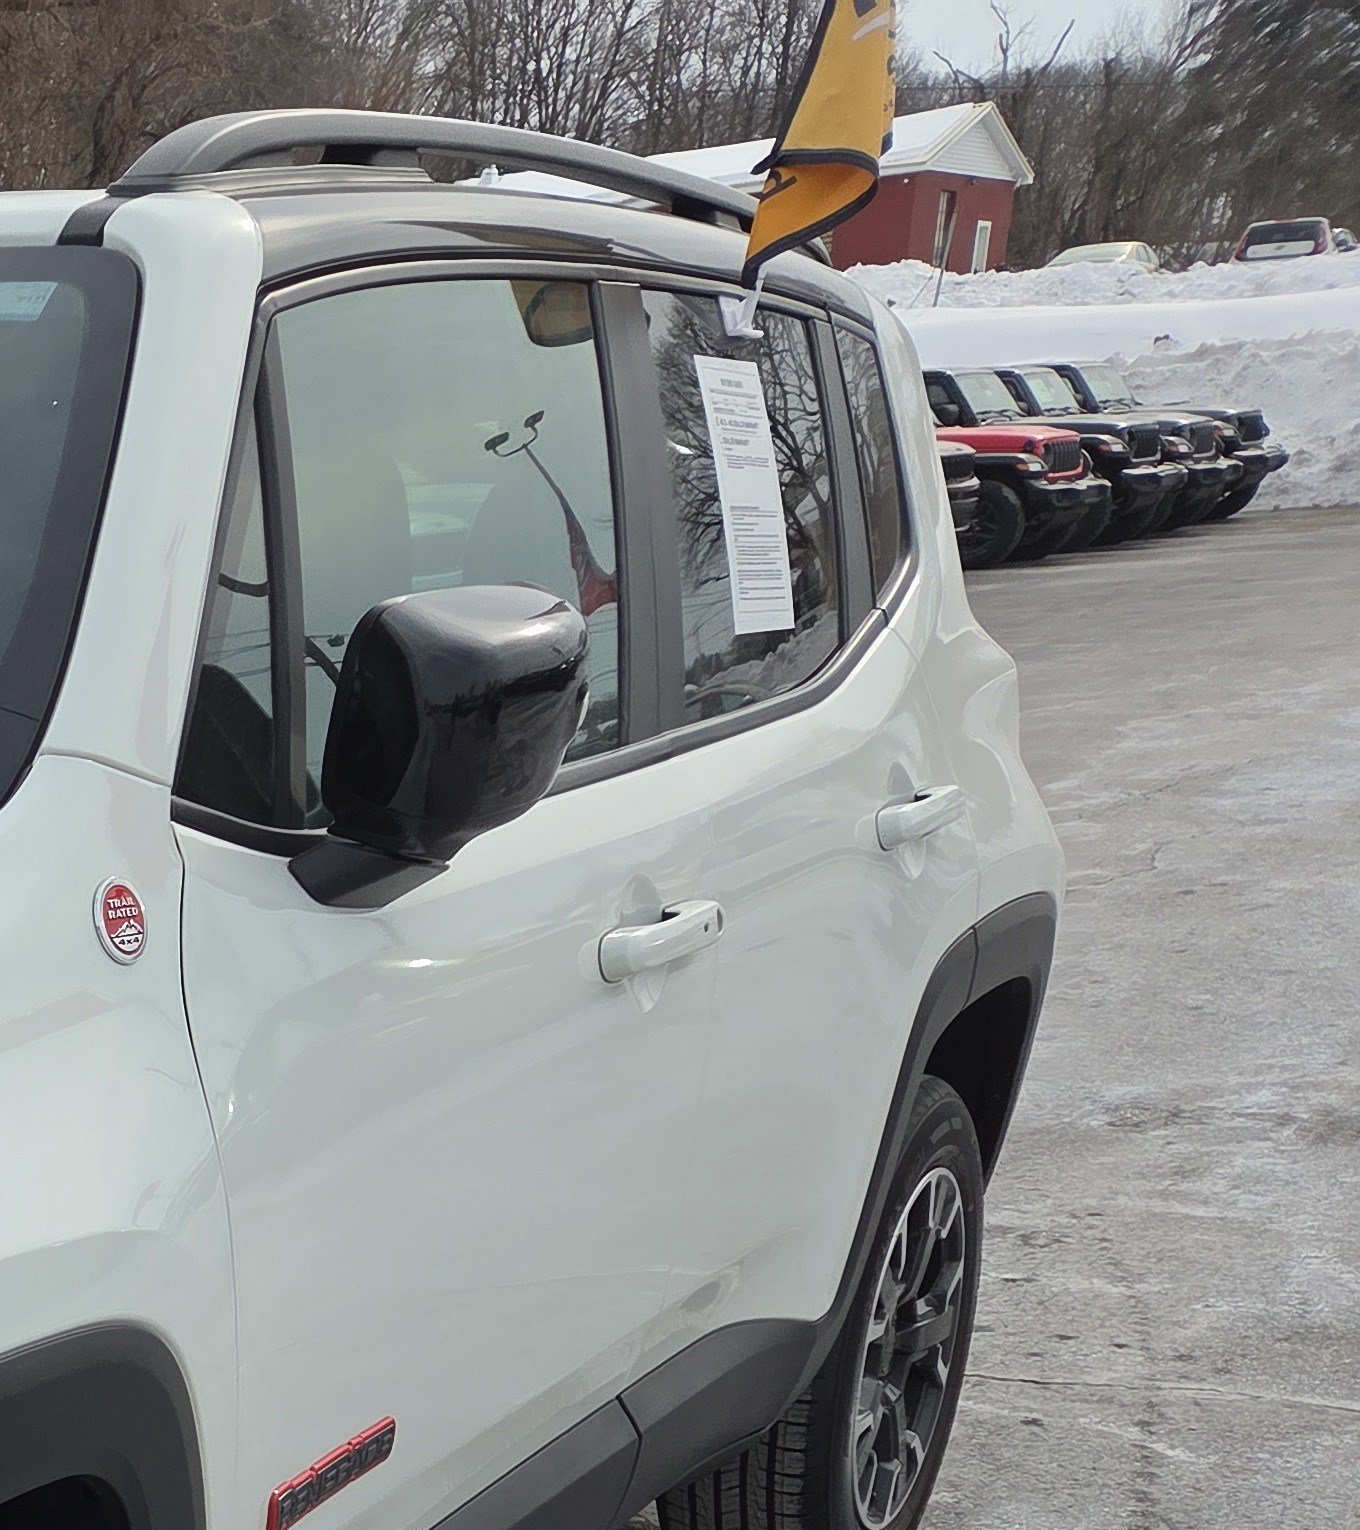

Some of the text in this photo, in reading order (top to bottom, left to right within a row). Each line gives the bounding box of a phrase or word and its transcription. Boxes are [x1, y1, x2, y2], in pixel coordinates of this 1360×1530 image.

[107, 896, 135, 908] TRAIL
[108, 907, 139, 920] RATED
[118, 937, 140, 946] 4x4
